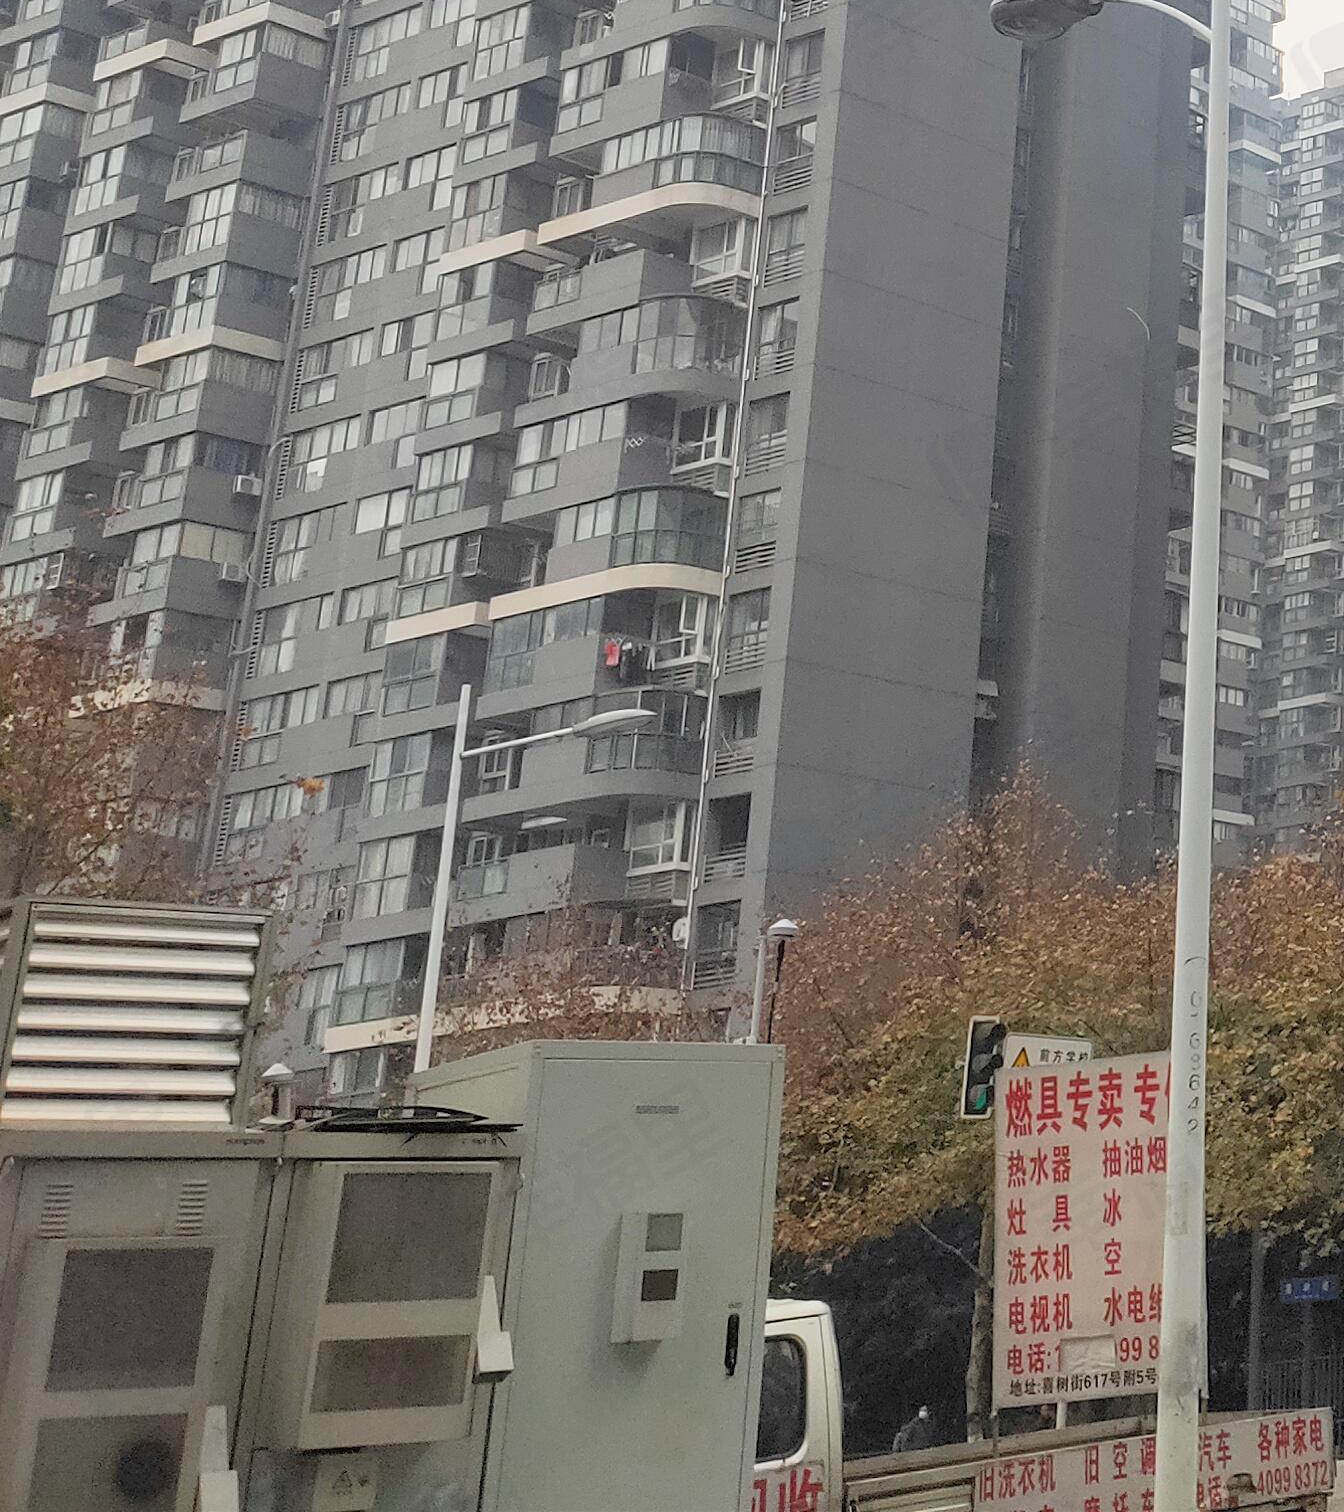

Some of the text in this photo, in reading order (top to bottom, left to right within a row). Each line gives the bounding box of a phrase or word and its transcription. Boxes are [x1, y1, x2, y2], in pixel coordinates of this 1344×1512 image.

[1005, 1063, 1171, 1138] 燃具专卖 专
[1007, 1136, 1167, 1189] 热水器 抽油烟
[1102, 1188, 1122, 1227] 冰
[1007, 1238, 1122, 1286] 洗衣机 空
[1008, 1293, 1073, 1335] 电视机
[978, 1454, 1057, 1502] 旧洗衣机
[1257, 1414, 1325, 1464] 各种家电
